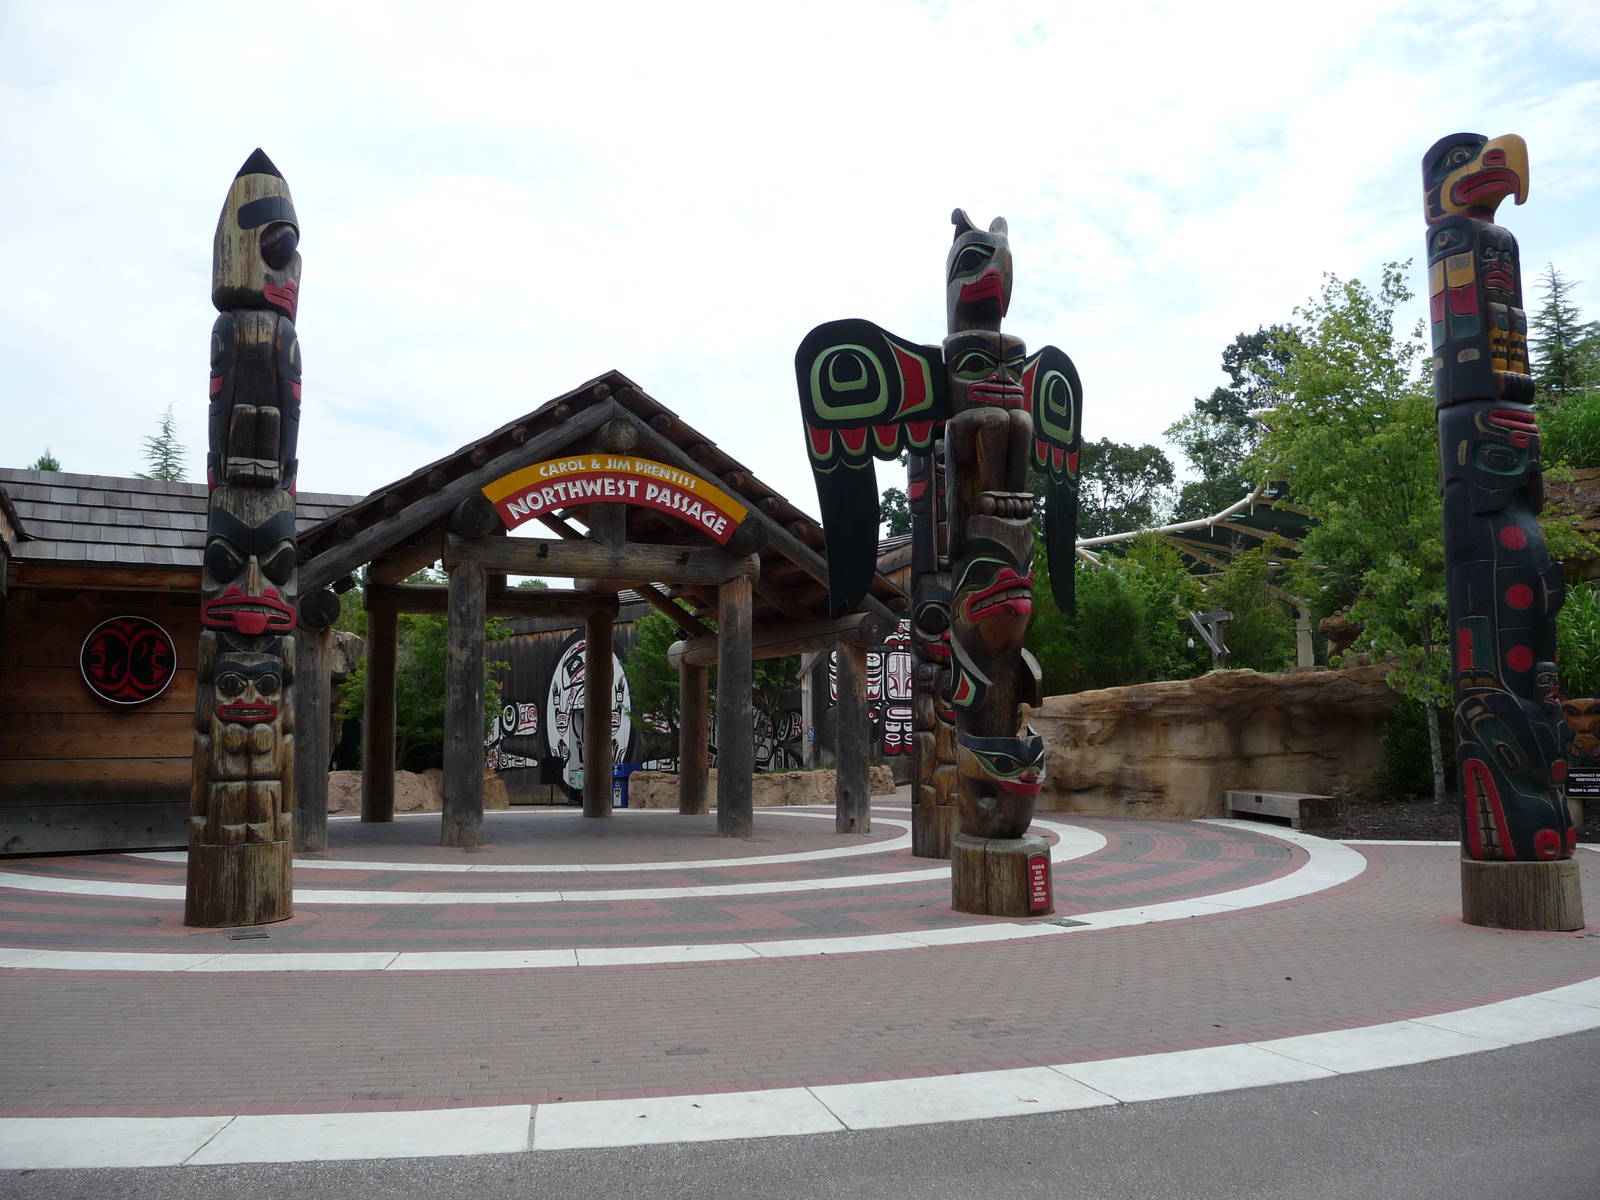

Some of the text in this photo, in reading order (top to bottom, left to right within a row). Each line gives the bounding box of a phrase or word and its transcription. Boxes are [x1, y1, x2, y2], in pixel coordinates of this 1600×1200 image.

[540, 458, 697, 489] CAROL & JIM PRENTISS
[506, 477, 728, 536] NORTHWEST PASSAGE
